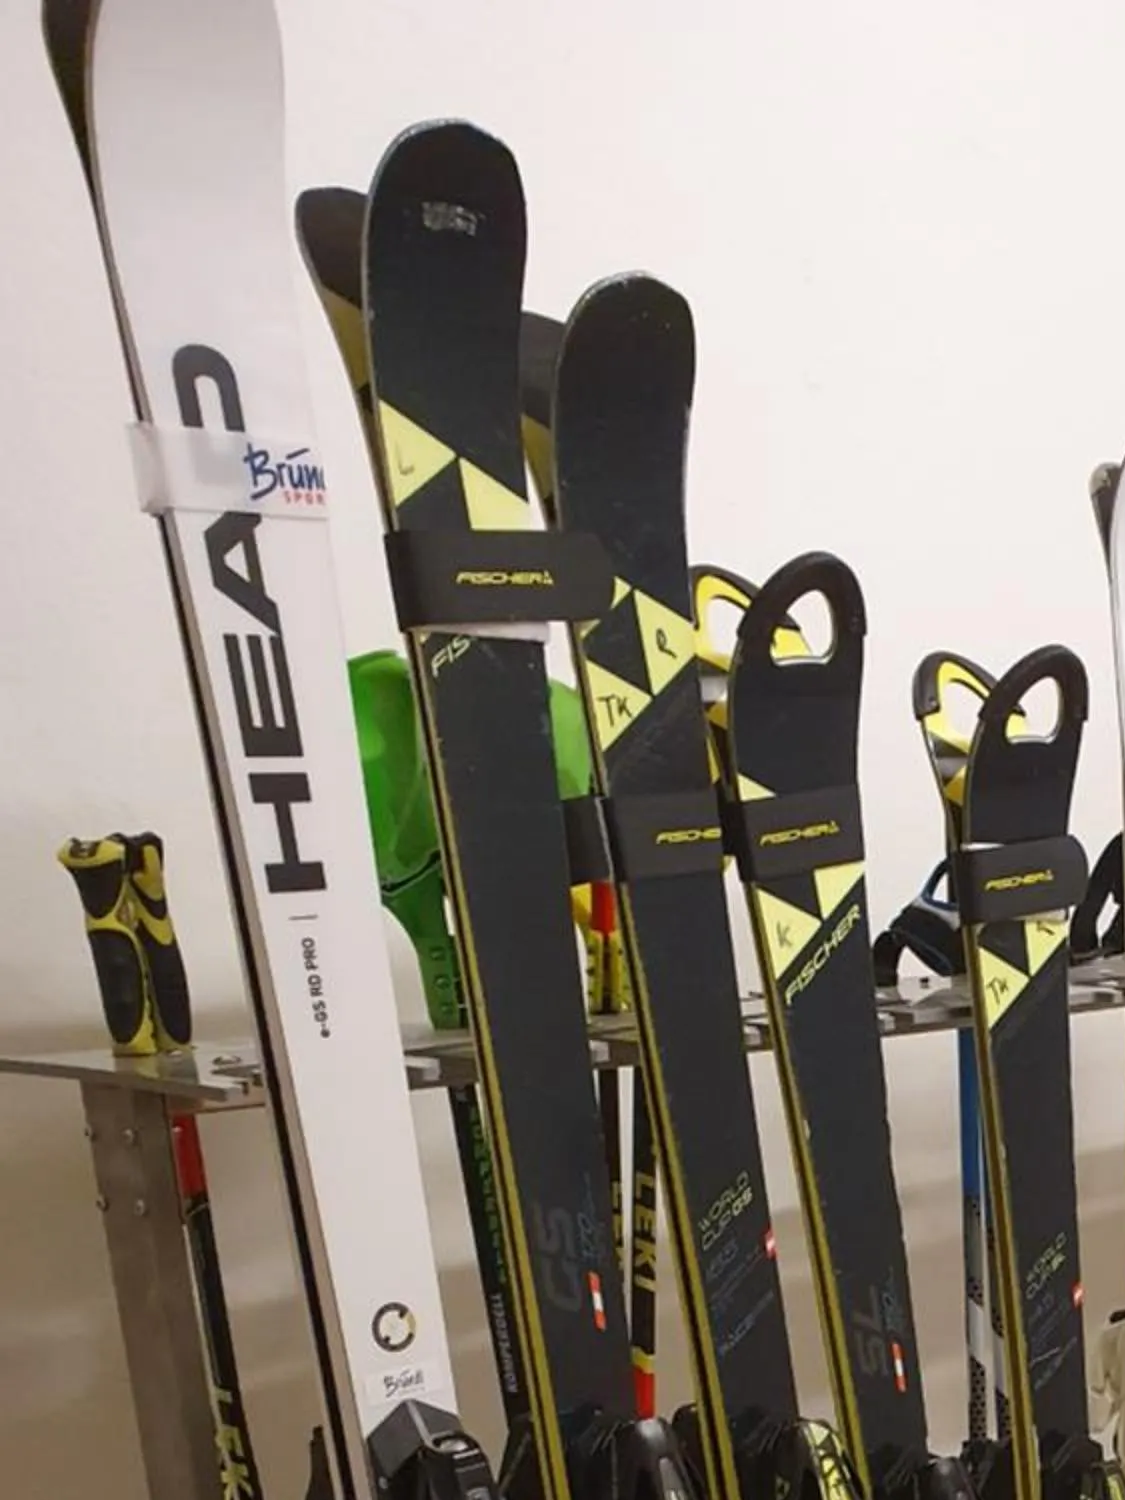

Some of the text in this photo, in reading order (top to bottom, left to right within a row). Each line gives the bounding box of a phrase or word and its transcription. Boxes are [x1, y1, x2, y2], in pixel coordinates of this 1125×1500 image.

[283, 491, 326, 506] SPOR
[456, 571, 542, 585] FISCHER
[172, 343, 327, 893] HEAD
[656, 827, 722, 845] FISCHE
[760, 824, 830, 847] FISCHER
[984, 871, 1046, 892] FISCHER
[301, 936, 316, 972] PRO
[785, 903, 861, 1006] FISCHER
[635, 1172, 657, 1293] LEKI
